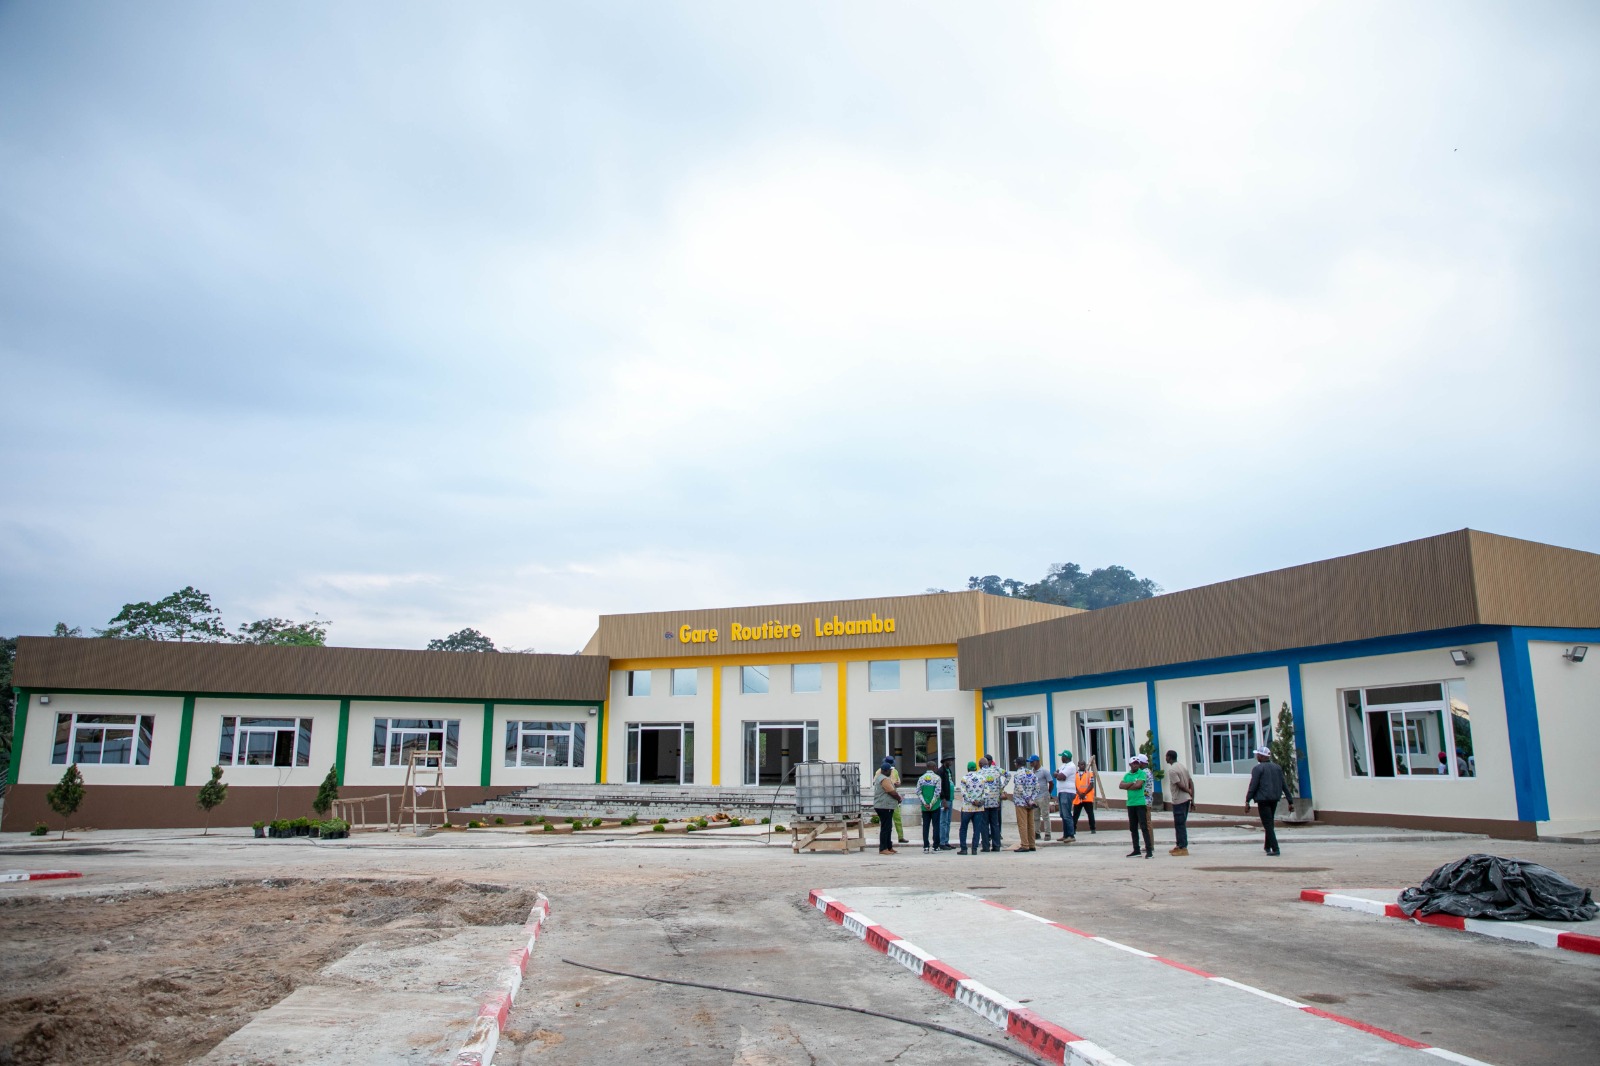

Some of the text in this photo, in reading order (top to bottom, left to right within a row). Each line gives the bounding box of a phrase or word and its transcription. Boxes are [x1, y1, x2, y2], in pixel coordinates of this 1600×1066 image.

[679, 613, 895, 643] Gare Routière Lebamba
